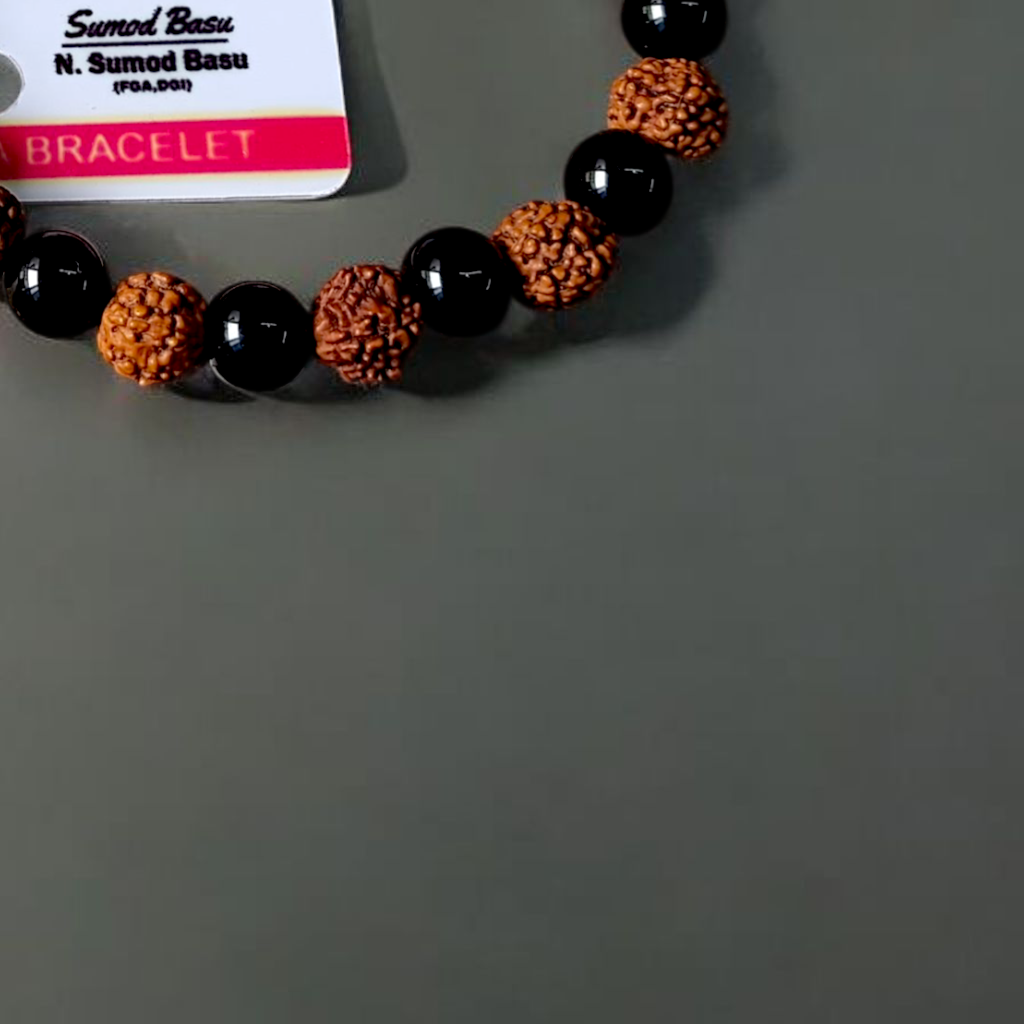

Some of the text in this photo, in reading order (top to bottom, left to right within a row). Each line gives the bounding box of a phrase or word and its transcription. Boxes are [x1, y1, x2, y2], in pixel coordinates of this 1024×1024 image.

[64, 6, 235, 38] Sumod Basu
[54, 49, 249, 75] N. Sumod Basu
[26, 130, 255, 166] BRACELET
